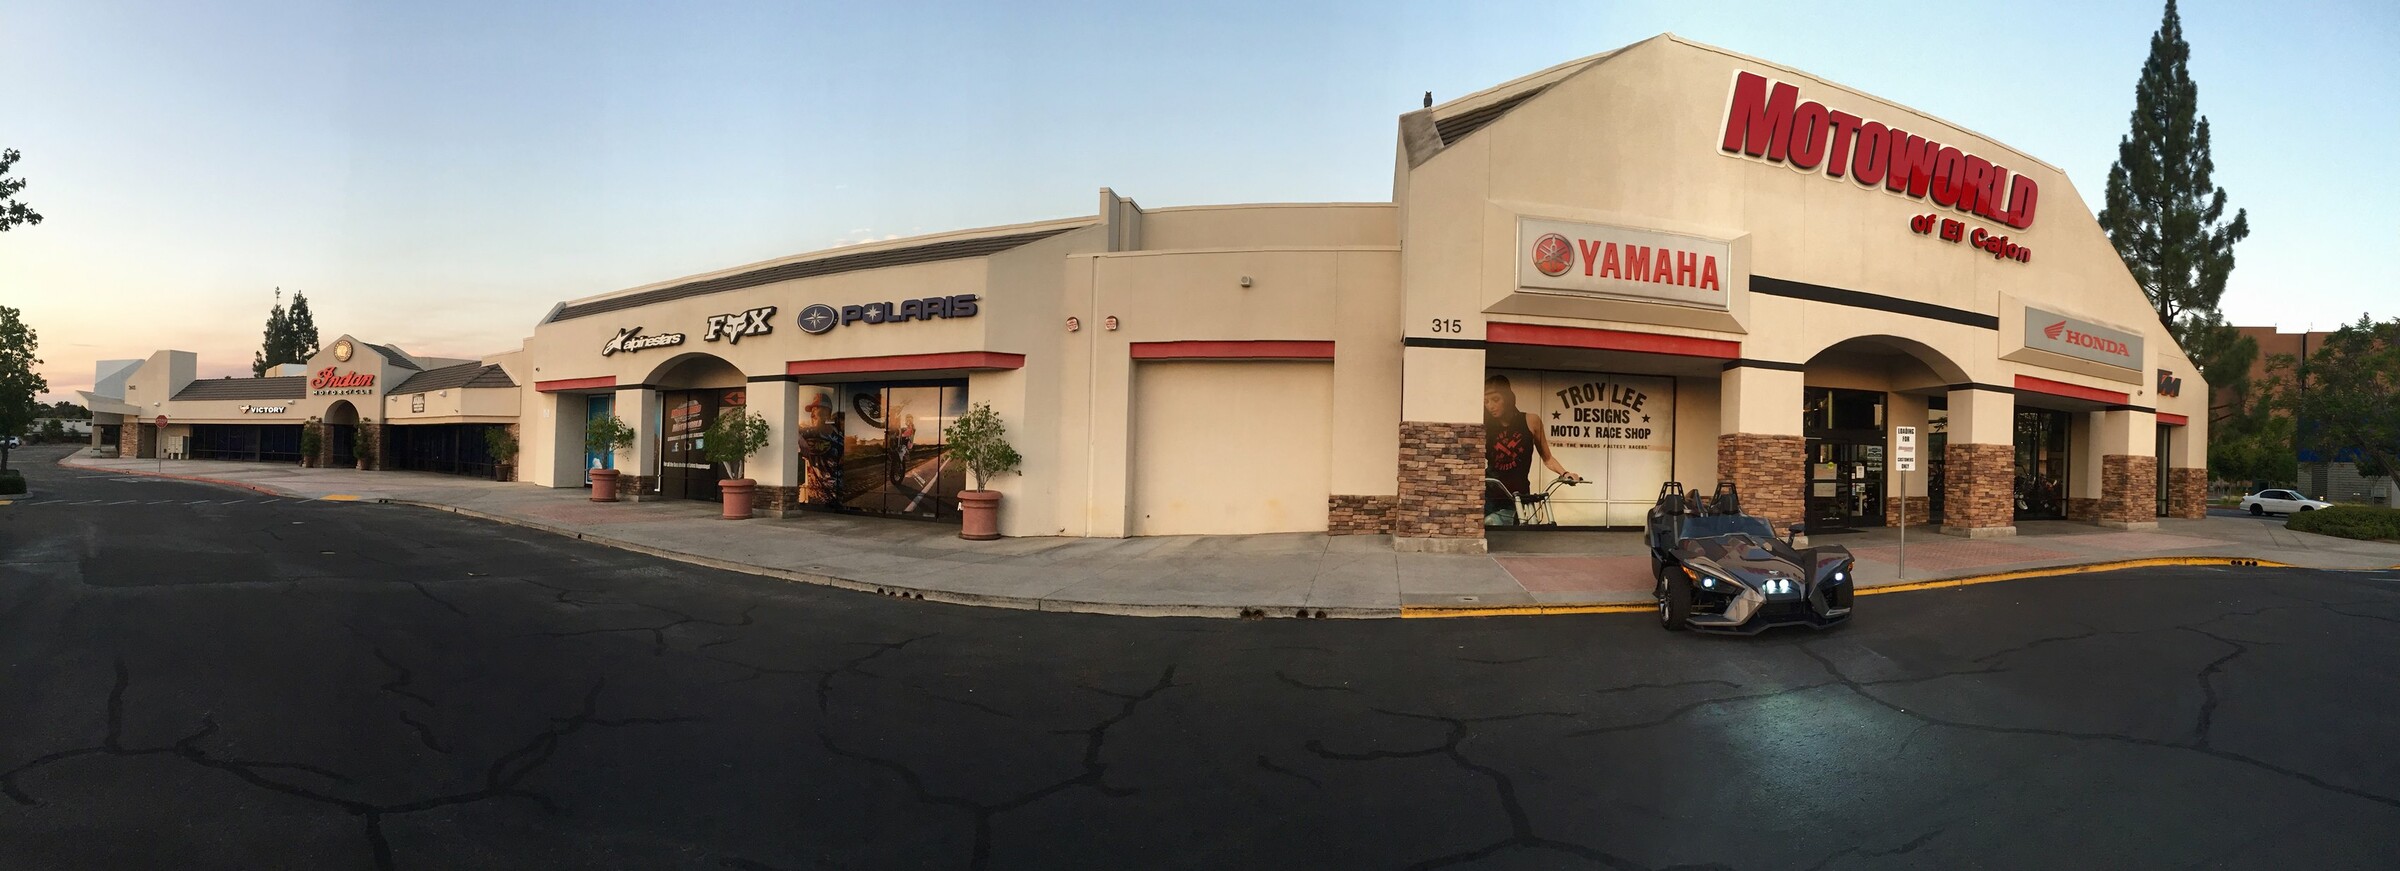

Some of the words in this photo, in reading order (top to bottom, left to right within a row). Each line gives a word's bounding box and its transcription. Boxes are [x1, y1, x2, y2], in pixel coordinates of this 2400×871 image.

[1721, 69, 2039, 230] MOTOWORLD
[1911, 213, 1937, 235] of
[1939, 217, 1965, 244] El
[1970, 226, 2032, 264] Cajon
[1577, 238, 1720, 292] YAMAHA
[841, 293, 979, 328] POLARIS
[1431, 318, 1462, 334] 315
[623, 333, 685, 353] alpinestars
[2065, 329, 2131, 357] HONDA
[311, 366, 375, 390] Indian
[250, 406, 286, 414] VICTORY
[1556, 382, 1606, 410] TROY
[1611, 383, 1648, 413] LEE
[1573, 407, 1631, 424] DESIGNS
[1550, 425, 1580, 438] MOTO
[1583, 426, 1591, 438] X
[1595, 427, 1622, 439] RACE
[1624, 427, 1652, 440] SHOP
